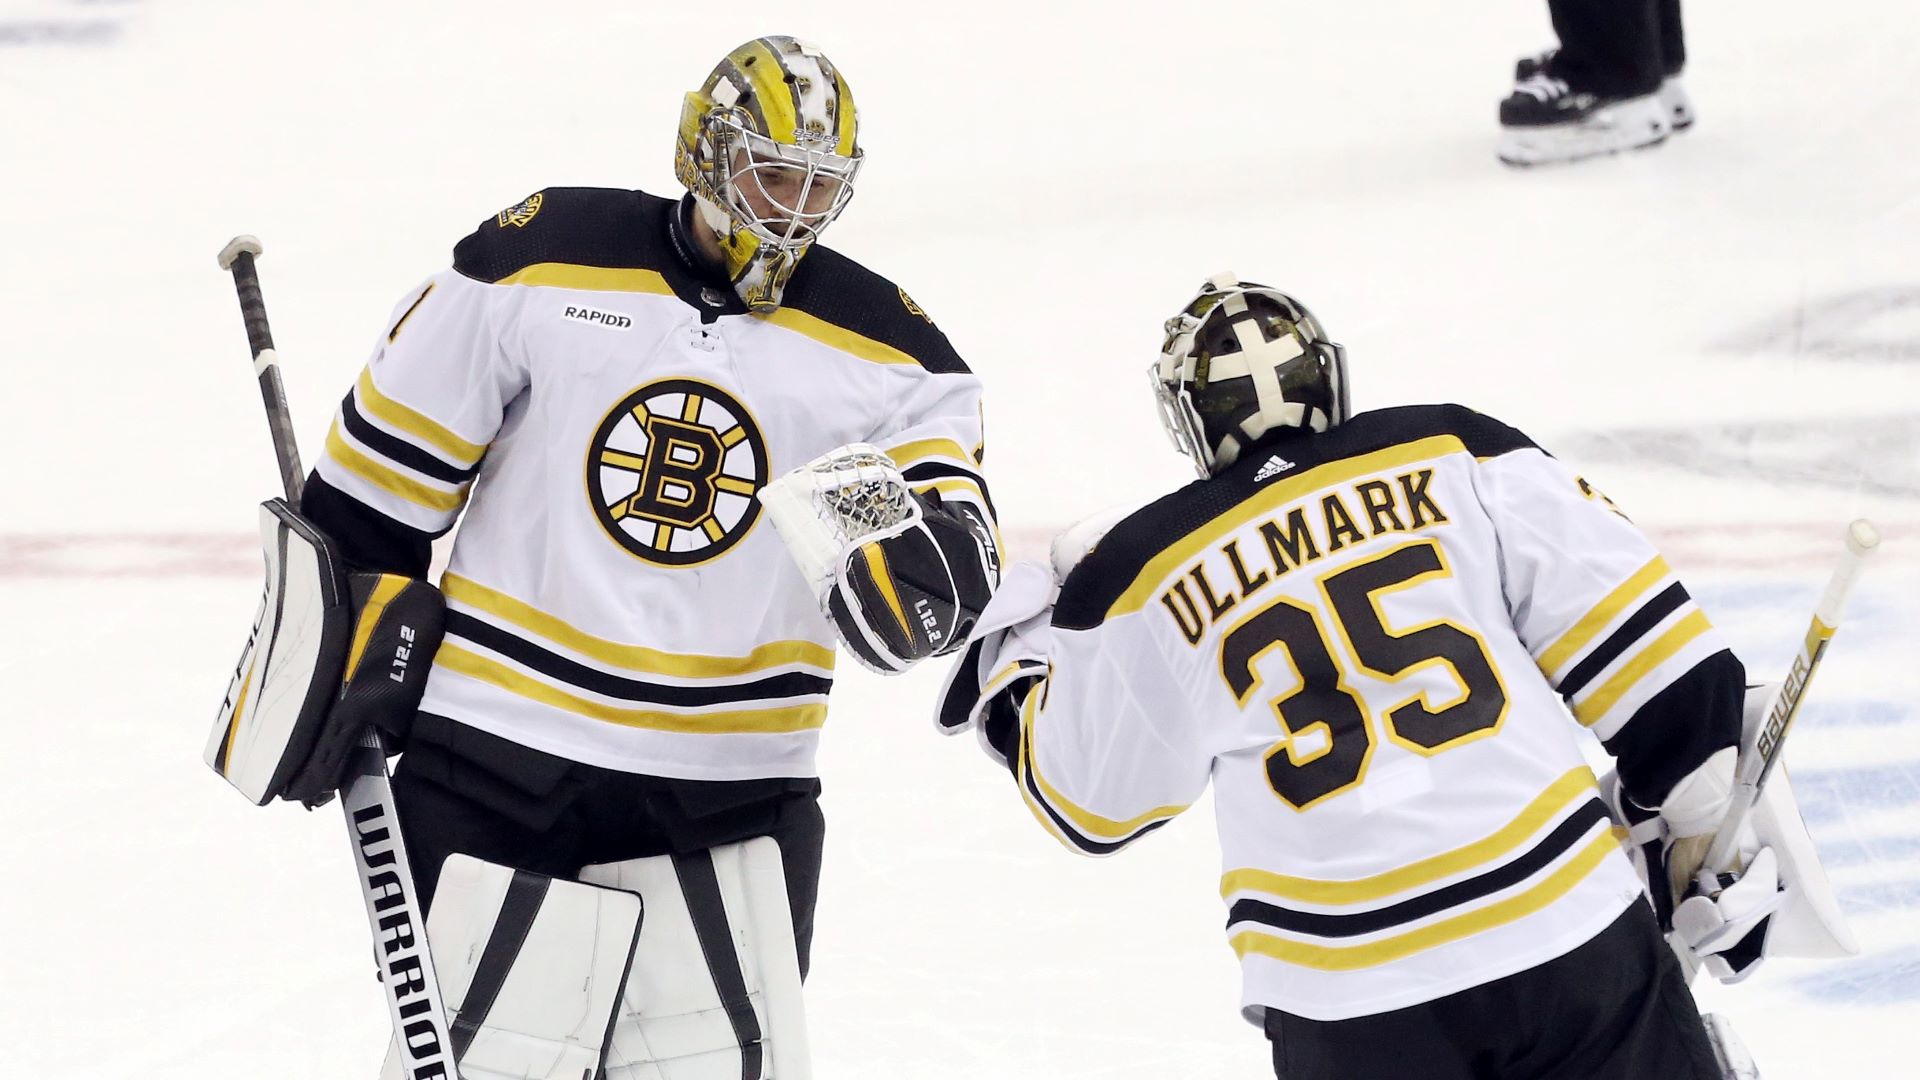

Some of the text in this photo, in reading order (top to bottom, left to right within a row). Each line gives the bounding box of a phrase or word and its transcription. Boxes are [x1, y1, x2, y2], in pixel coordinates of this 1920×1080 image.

[627, 414, 726, 529] B
[1253, 462, 1297, 482] adidas
[1159, 468, 1450, 647] ULLMARK
[390, 624, 416, 683] L12.2
[914, 598, 943, 643] L12.2
[1217, 536, 1512, 813] 35
